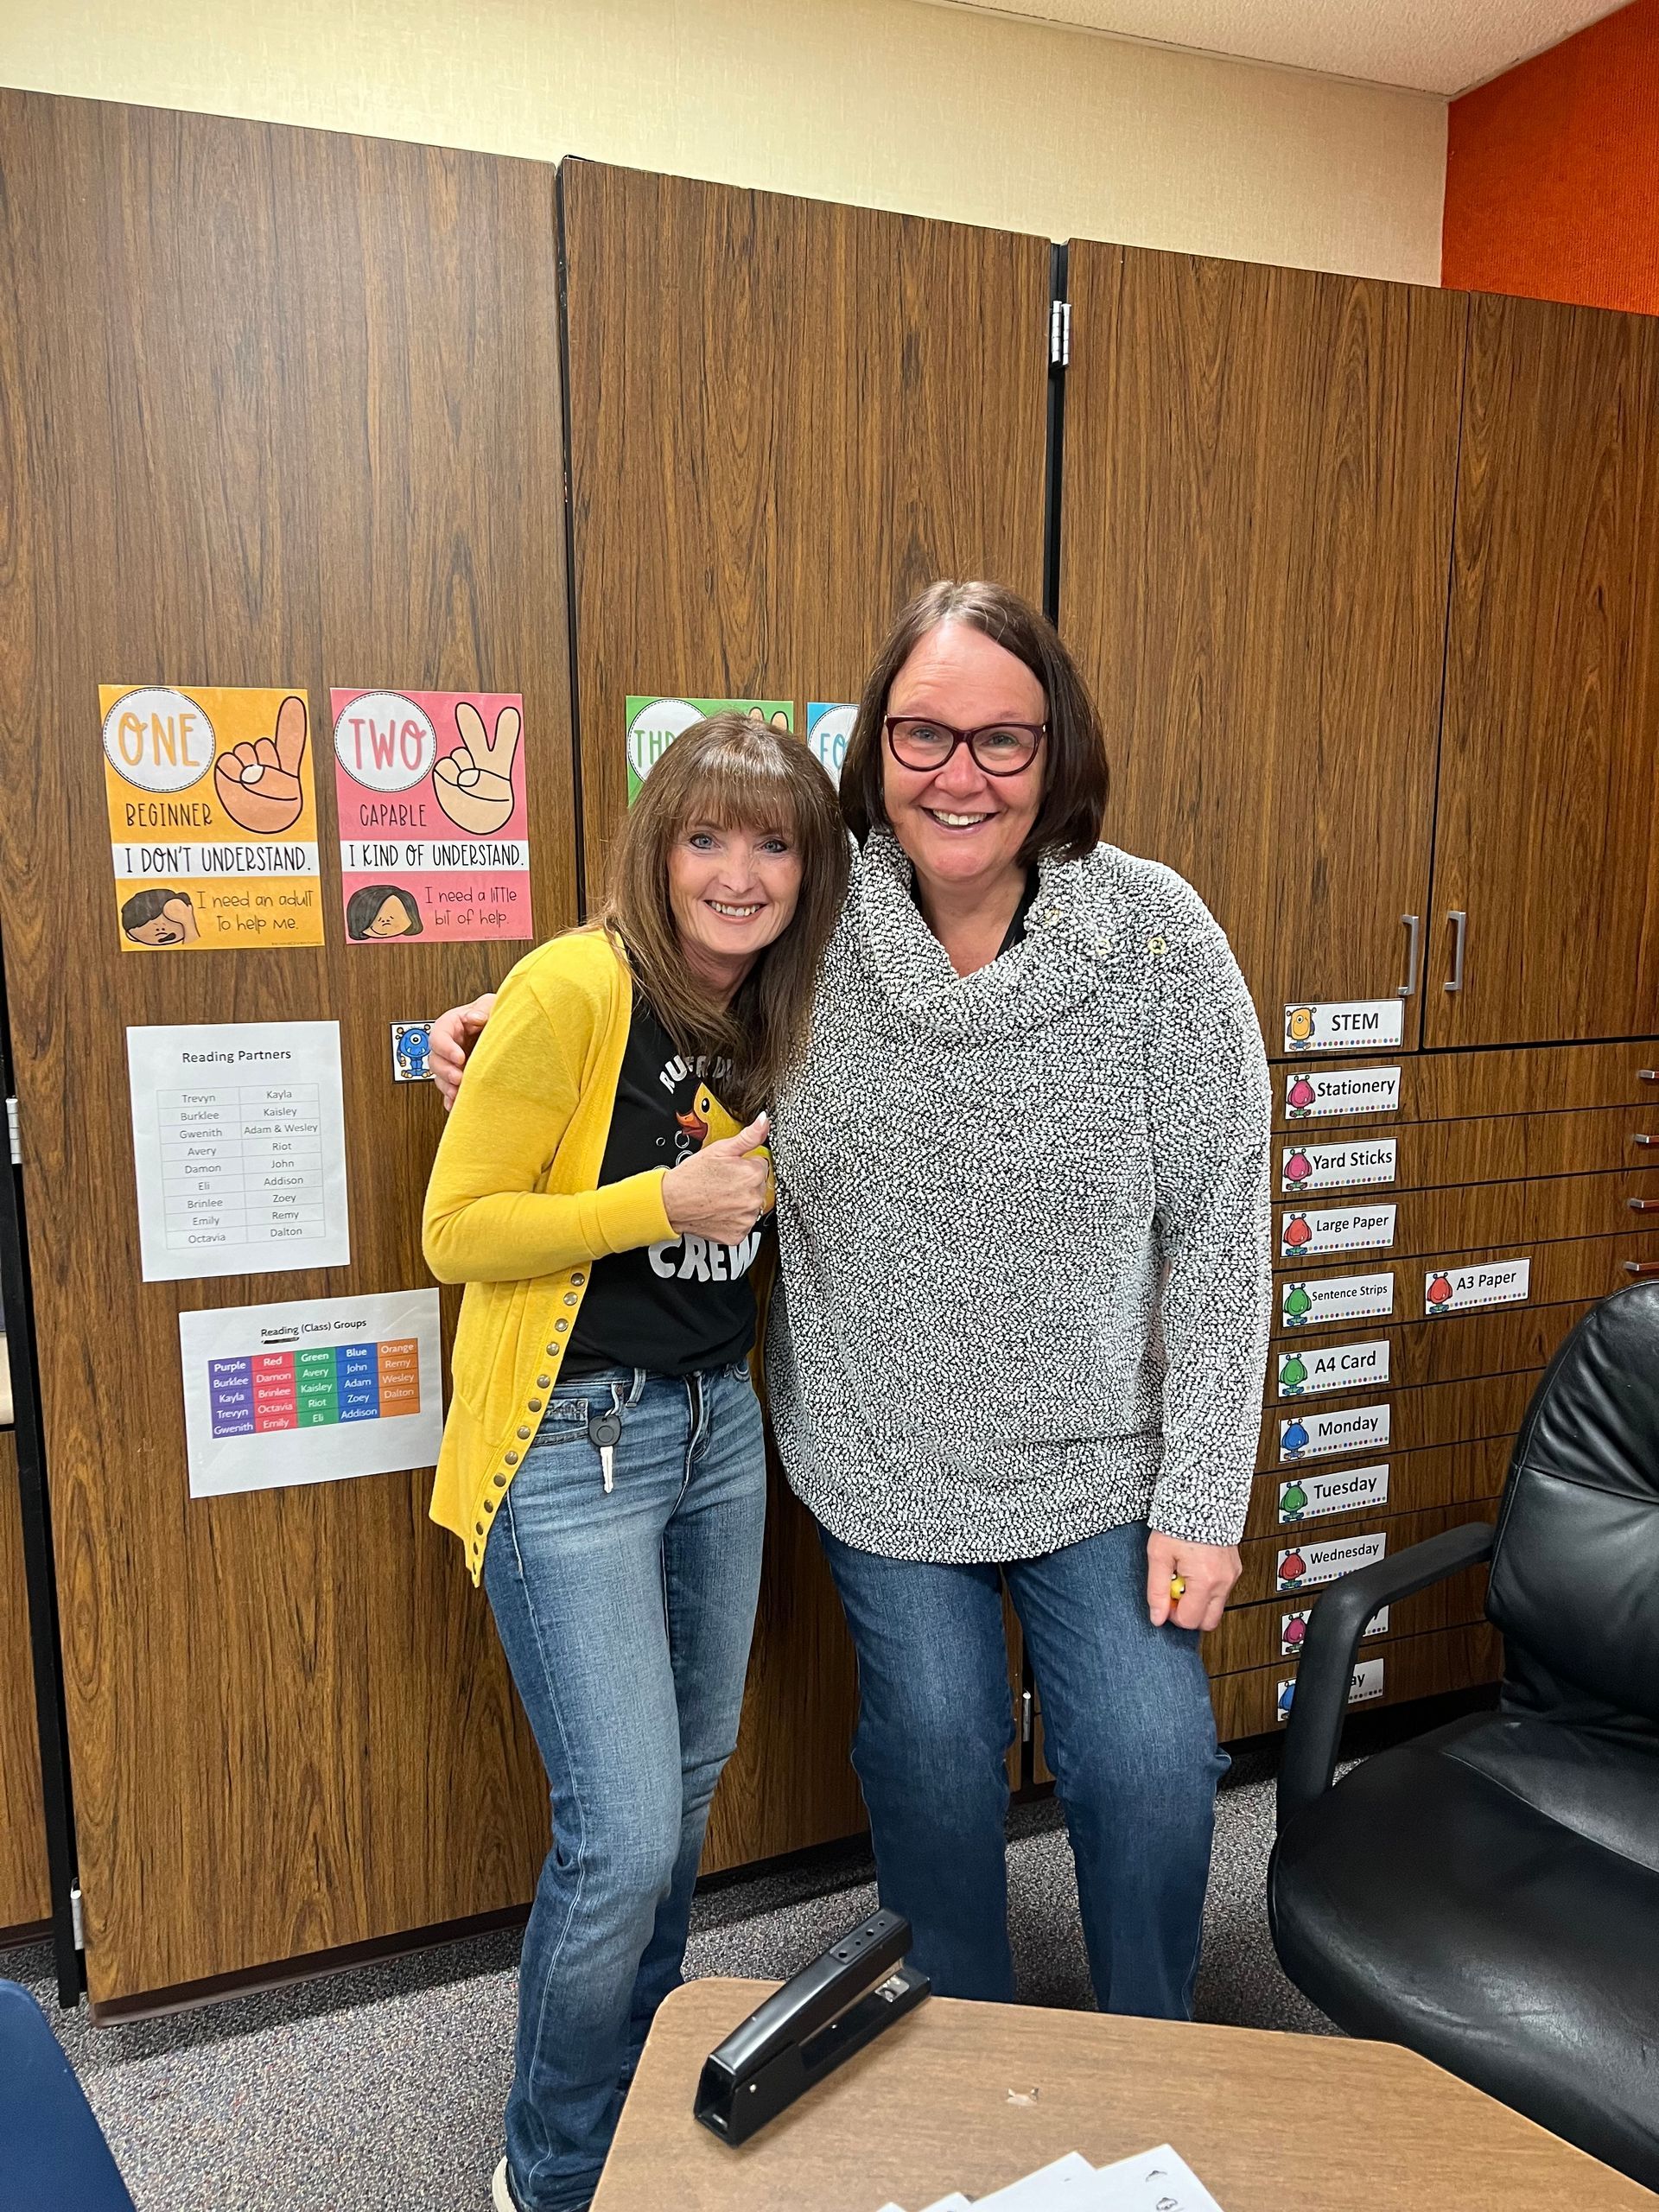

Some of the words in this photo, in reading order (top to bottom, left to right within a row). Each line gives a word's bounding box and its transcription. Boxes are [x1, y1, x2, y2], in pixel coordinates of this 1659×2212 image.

[118, 712, 200, 766] ONE
[349, 719, 427, 771] TWO
[125, 803, 213, 827] BEGINNER
[359, 804, 427, 827] CAPABLE
[124, 848, 133, 873] I
[141, 845, 192, 874] DON'T
[201, 846, 312, 873] UNDERSTAND.
[349, 844, 355, 867] I
[362, 844, 398, 867] KIND
[405, 844, 425, 867] OF
[432, 844, 525, 867] UNDERSTAND.
[196, 891, 206, 909] I
[213, 891, 251, 907] need
[256, 895, 274, 906] an
[425, 887, 433, 904] I
[439, 887, 473, 903] need
[478, 893, 486, 902] a
[457, 909, 474, 925] of
[236, 916, 266, 934] help
[1332, 1012, 1380, 1032] STEM
[182, 1052, 234, 1064] Reading
[238, 1049, 291, 1062] Partners
[1317, 1079, 1396, 1097] Stationery
[181, 1094, 216, 1104] Trevyn
[266, 1090, 292, 1101] Kayla
[180, 1111, 219, 1122] Burklee
[264, 1107, 297, 1118] Kaisley
[179, 1128, 223, 1140] Gwenith
[244, 1126, 272, 1135] Adam
[274, 1124, 282, 1134] &
[285, 1122, 318, 1135] Wesley
[187, 1147, 217, 1158] Avery
[272, 1141, 292, 1152] Riot
[271, 1159, 295, 1169] John
[1313, 1152, 1346, 1170] Yard
[1350, 1148, 1393, 1166] Sticks
[184, 1164, 222, 1174] Damon
[198, 1181, 210, 1191] Eli
[264, 1175, 303, 1187] Addison
[187, 1198, 224, 1209] Brinlee
[272, 1193, 296, 1205] Zoey
[193, 1216, 220, 1227] Emily
[272, 1210, 300, 1221] Remy
[1316, 1219, 1350, 1233] Large
[1353, 1216, 1389, 1230] Paper
[270, 1227, 302, 1238] Dalton
[188, 1234, 226, 1244] Octavia
[648, 1231, 761, 1281] CREW
[1456, 1275, 1474, 1291] A3
[1478, 1272, 1516, 1287] Paper
[1312, 1287, 1357, 1301] Sentence
[1359, 1284, 1389, 1300] Strips
[261, 1325, 299, 1338] Reading
[302, 1321, 331, 1334] (Class)
[334, 1319, 367, 1331] Groups
[346, 1348, 367, 1357] Blue
[380, 1344, 414, 1354] Orange
[263, 1356, 283, 1366] Red
[301, 1352, 329, 1363] Green
[1314, 1357, 1336, 1374] A4
[1340, 1351, 1376, 1370] Card
[214, 1360, 246, 1373] Purple
[346, 1363, 367, 1374] John
[385, 1359, 411, 1369] Remy
[256, 1372, 291, 1383] Damon
[302, 1368, 329, 1378] Avery
[382, 1373, 415, 1384] Wesley
[213, 1376, 249, 1389] Burklee
[301, 1382, 333, 1394] Kaisley
[344, 1378, 372, 1389] Adam
[219, 1392, 245, 1404] Kayla
[257, 1388, 291, 1399] Brinlee
[347, 1394, 370, 1404] Zoey
[384, 1389, 415, 1399] Dalton
[257, 1402, 293, 1414] Octavia
[308, 1398, 327, 1408] Riot
[216, 1408, 249, 1420] Trevyn
[312, 1413, 325, 1423] Eli
[340, 1408, 378, 1420] Addison
[213, 1421, 254, 1435] Gwenith
[263, 1418, 289, 1429] Emily
[1319, 1414, 1379, 1437] Monday
[1313, 1476, 1377, 1499] Tuesday
[1310, 1543, 1380, 1565] Wednesday
